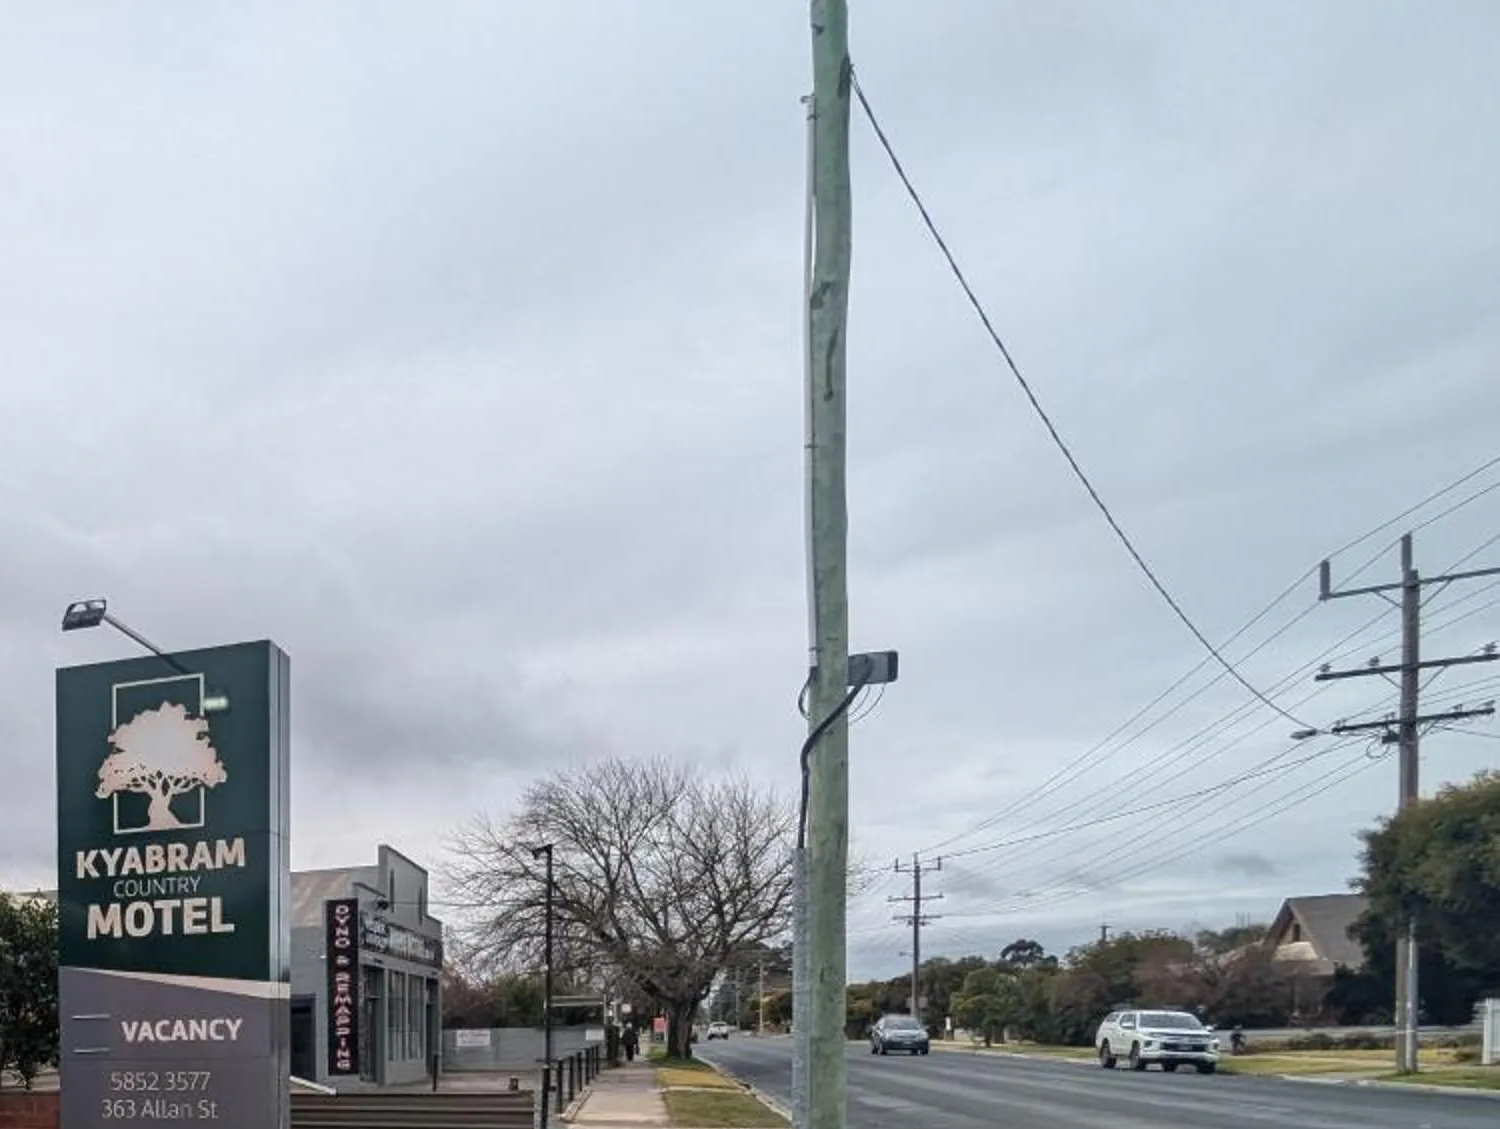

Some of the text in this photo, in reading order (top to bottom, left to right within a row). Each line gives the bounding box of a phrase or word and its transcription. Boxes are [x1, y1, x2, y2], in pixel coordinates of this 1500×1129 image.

[75, 838, 245, 878] KYABRAM
[113, 876, 200, 897] COUNTRY
[87, 897, 235, 939] MOTEL
[334, 905, 351, 948] DYNO
[121, 1018, 243, 1042] VACANCY
[110, 1071, 211, 1092] 5852 3577
[101, 1099, 218, 1119] 363 Allan St
